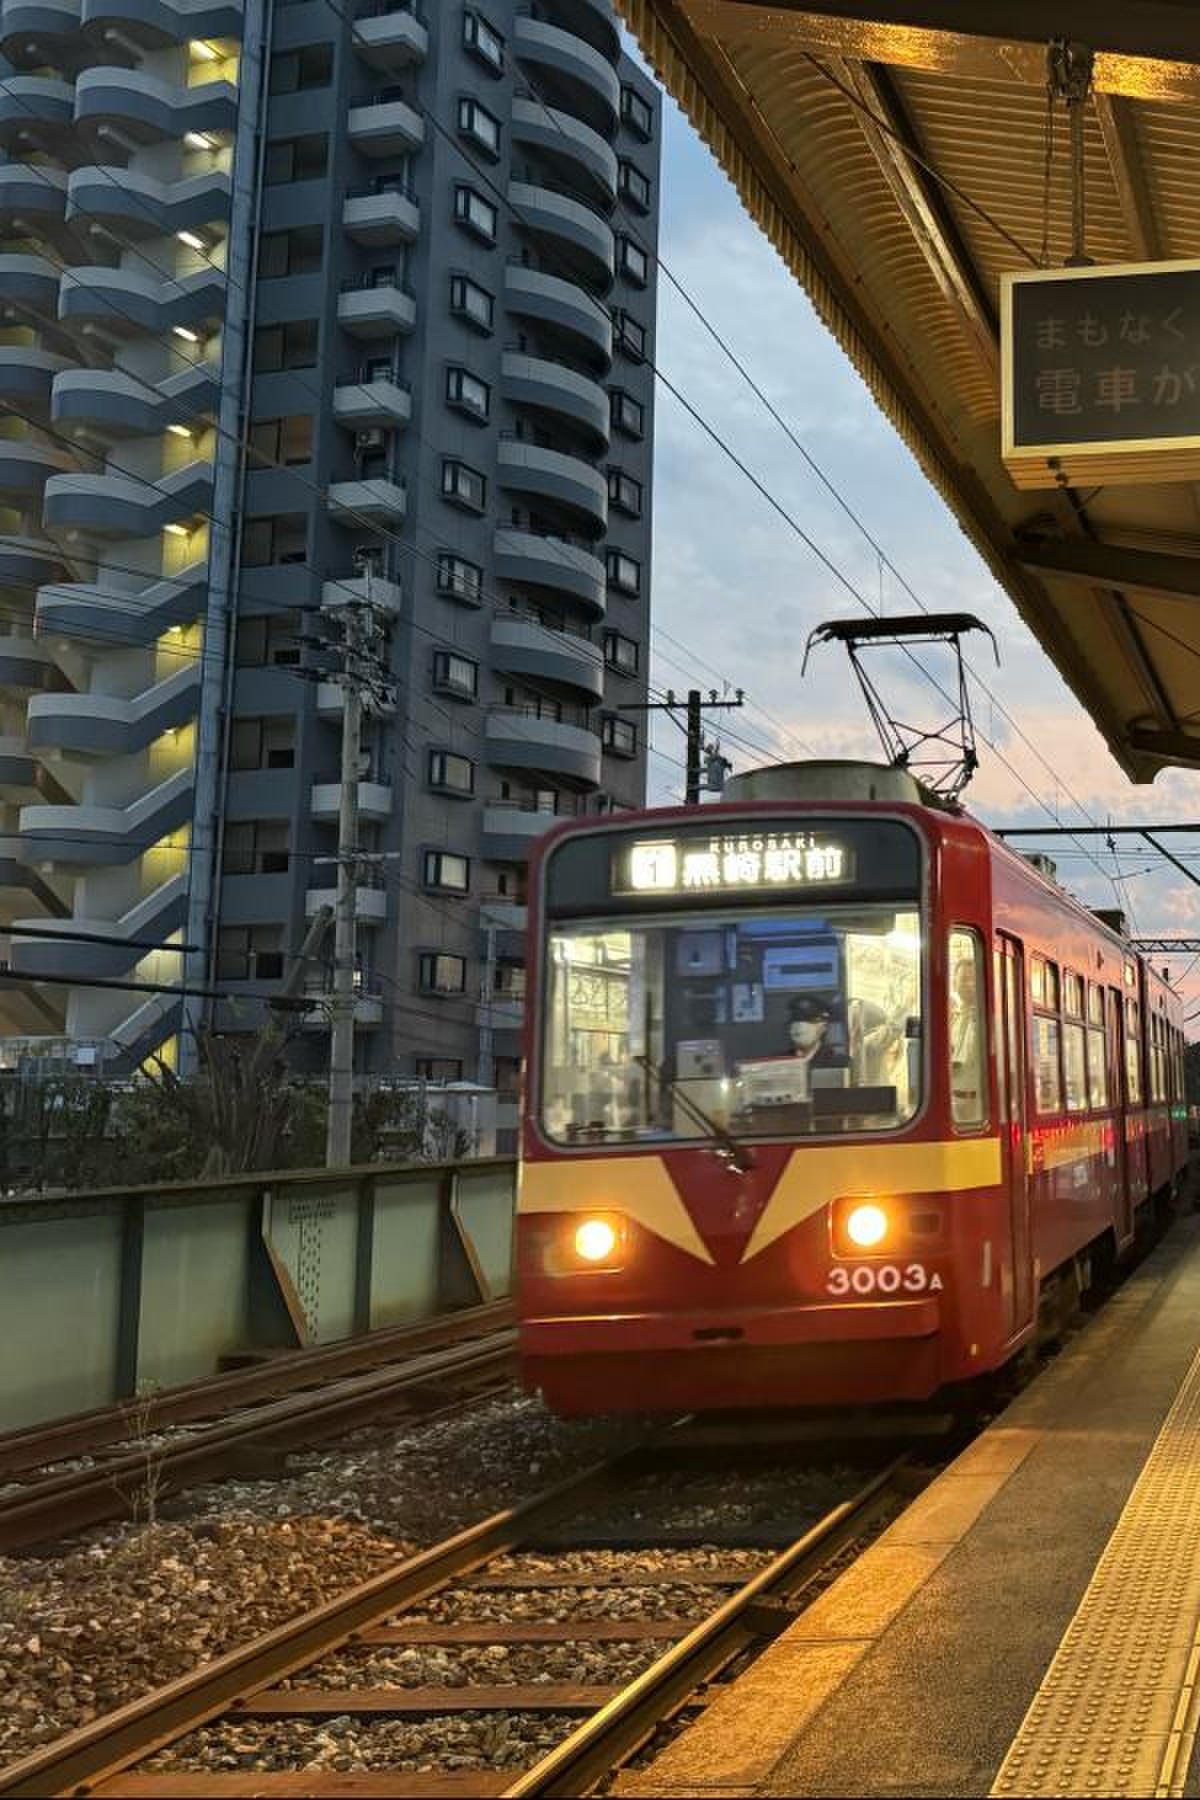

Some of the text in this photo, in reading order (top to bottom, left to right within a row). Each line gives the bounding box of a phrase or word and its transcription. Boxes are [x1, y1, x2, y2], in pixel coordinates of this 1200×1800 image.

[1035, 307, 1186, 351] まもなく
[709, 836, 816, 853] KUROSAKI
